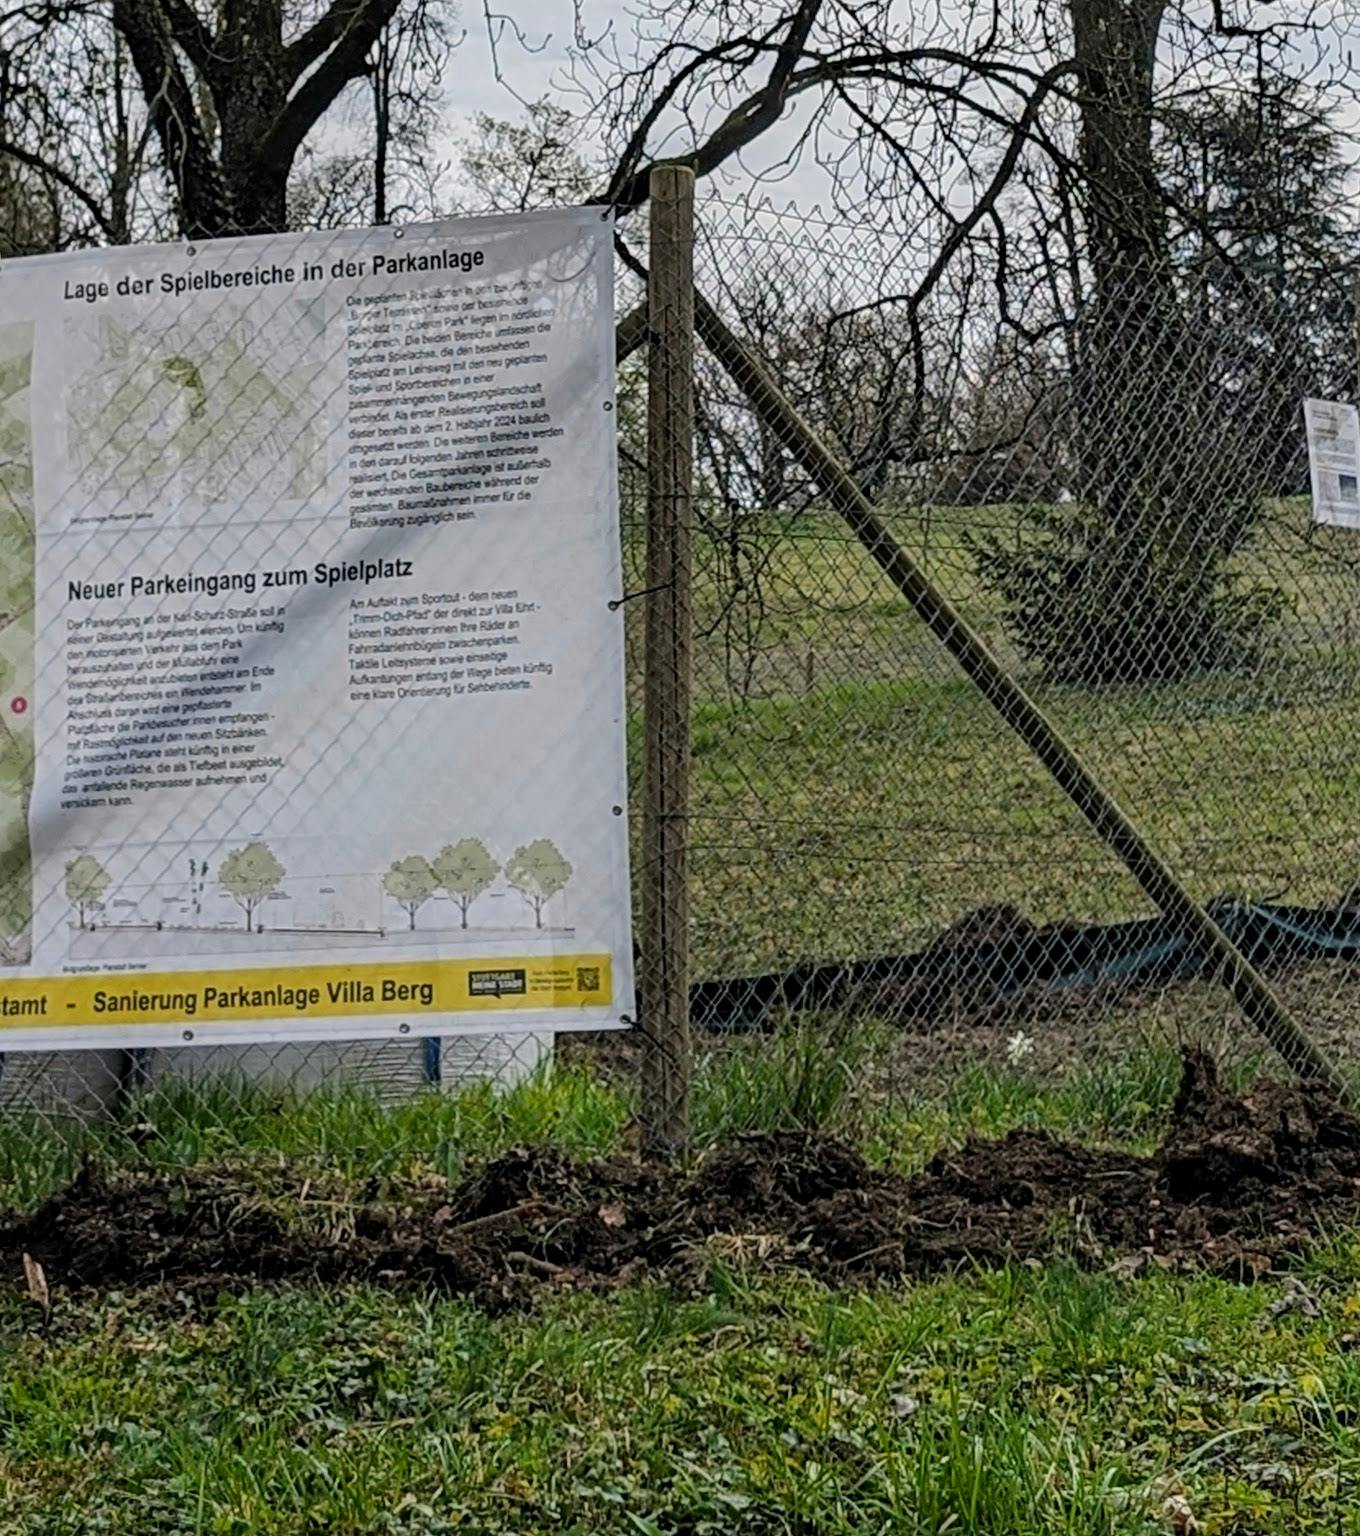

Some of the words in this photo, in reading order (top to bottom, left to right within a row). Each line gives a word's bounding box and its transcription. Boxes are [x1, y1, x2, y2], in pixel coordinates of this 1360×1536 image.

[64, 280, 108, 301] Lage
[116, 276, 152, 294] der
[160, 264, 294, 294] Spielbereiche
[303, 262, 322, 280] in
[331, 260, 366, 277] der
[372, 252, 484, 274] Parkanlage
[409, 423, 420, 433] ab
[494, 415, 515, 426] 2024
[518, 412, 550, 424] baulich
[433, 436, 448, 446] Die
[490, 429, 529, 441] Bereiche
[532, 426, 563, 437] werden
[349, 458, 356, 468] in
[359, 457, 375, 467] den
[409, 451, 452, 465] folgenden
[455, 448, 484, 459] Jahren
[391, 469, 406, 479] Die
[349, 488, 363, 497] der
[426, 479, 481, 492] Baubereiche
[524, 475, 538, 485] der
[69, 582, 123, 600] Neuer
[131, 574, 255, 595] Parkeingang
[263, 571, 307, 586] zum
[314, 560, 412, 586] Spielplatz
[350, 599, 364, 608] Am
[367, 596, 397, 607] Auftakt
[400, 597, 418, 605] zum
[421, 592, 459, 606] Sportcut
[468, 591, 488, 600] dem
[491, 590, 517, 599] neuen
[433, 608, 449, 618] der
[451, 606, 476, 617] direkt
[478, 607, 493, 615] zur
[495, 604, 512, 614] Villa
[348, 628, 380, 638] können
[460, 621, 476, 631] Ihre
[479, 619, 504, 630] Räder
[508, 620, 519, 628] an
[439, 652, 463, 663] sowie
[416, 670, 447, 682] entlang
[450, 668, 464, 678] der
[494, 666, 520, 675] bieten
[350, 689, 370, 699] eine
[372, 688, 394, 698] klare
[397, 685, 451, 696] Orientierung
[453, 683, 465, 692] für
[157, 762, 170, 772] die
[173, 761, 186, 771] als
[250, 771, 266, 781] und
[93, 990, 197, 1013] Sanierung
[203, 984, 319, 1008] Parkanlage
[325, 980, 374, 1001] Villa
[382, 979, 432, 1003] Berg
